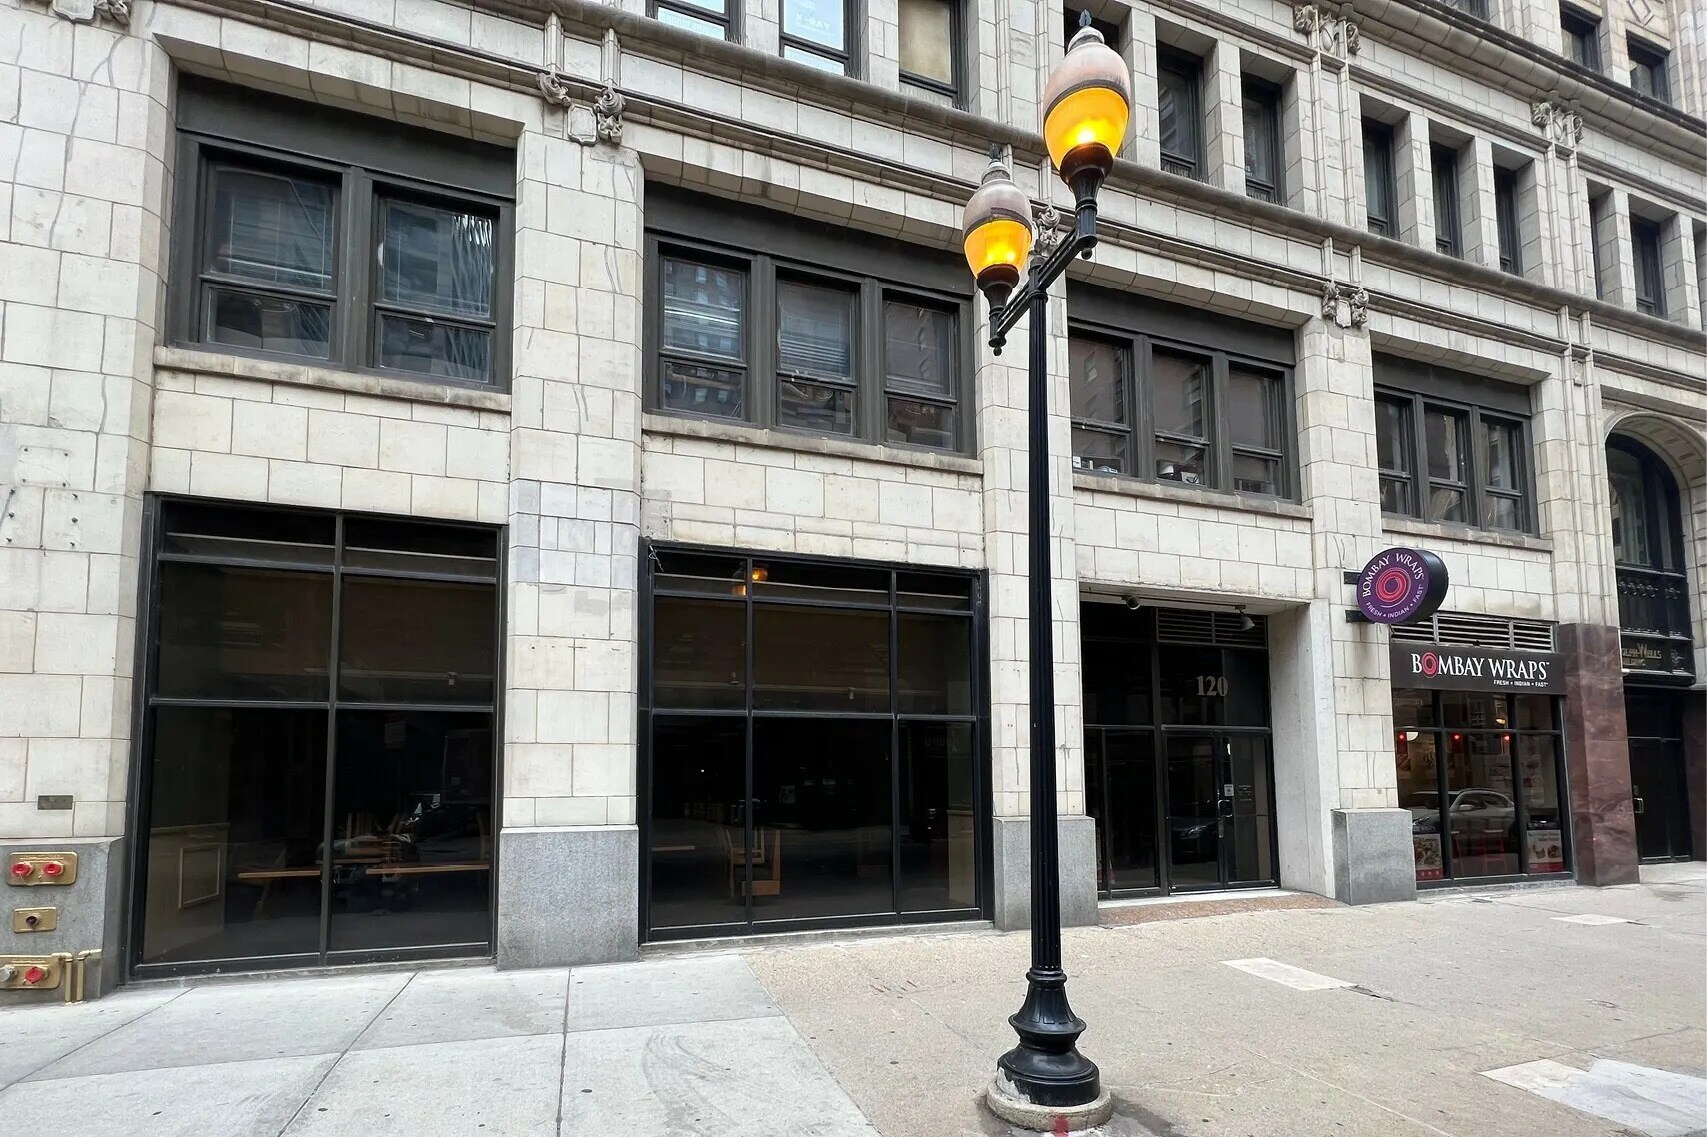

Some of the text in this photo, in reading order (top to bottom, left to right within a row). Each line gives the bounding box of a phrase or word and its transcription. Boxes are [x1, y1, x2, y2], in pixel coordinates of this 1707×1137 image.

[1362, 553, 1424, 597] BOMBAY WRAPS
[1366, 585, 1424, 618] FRESH INDIAN FAST
[1411, 652, 1548, 680] BOMBAY WRAPS
[1196, 675, 1229, 697] 120
